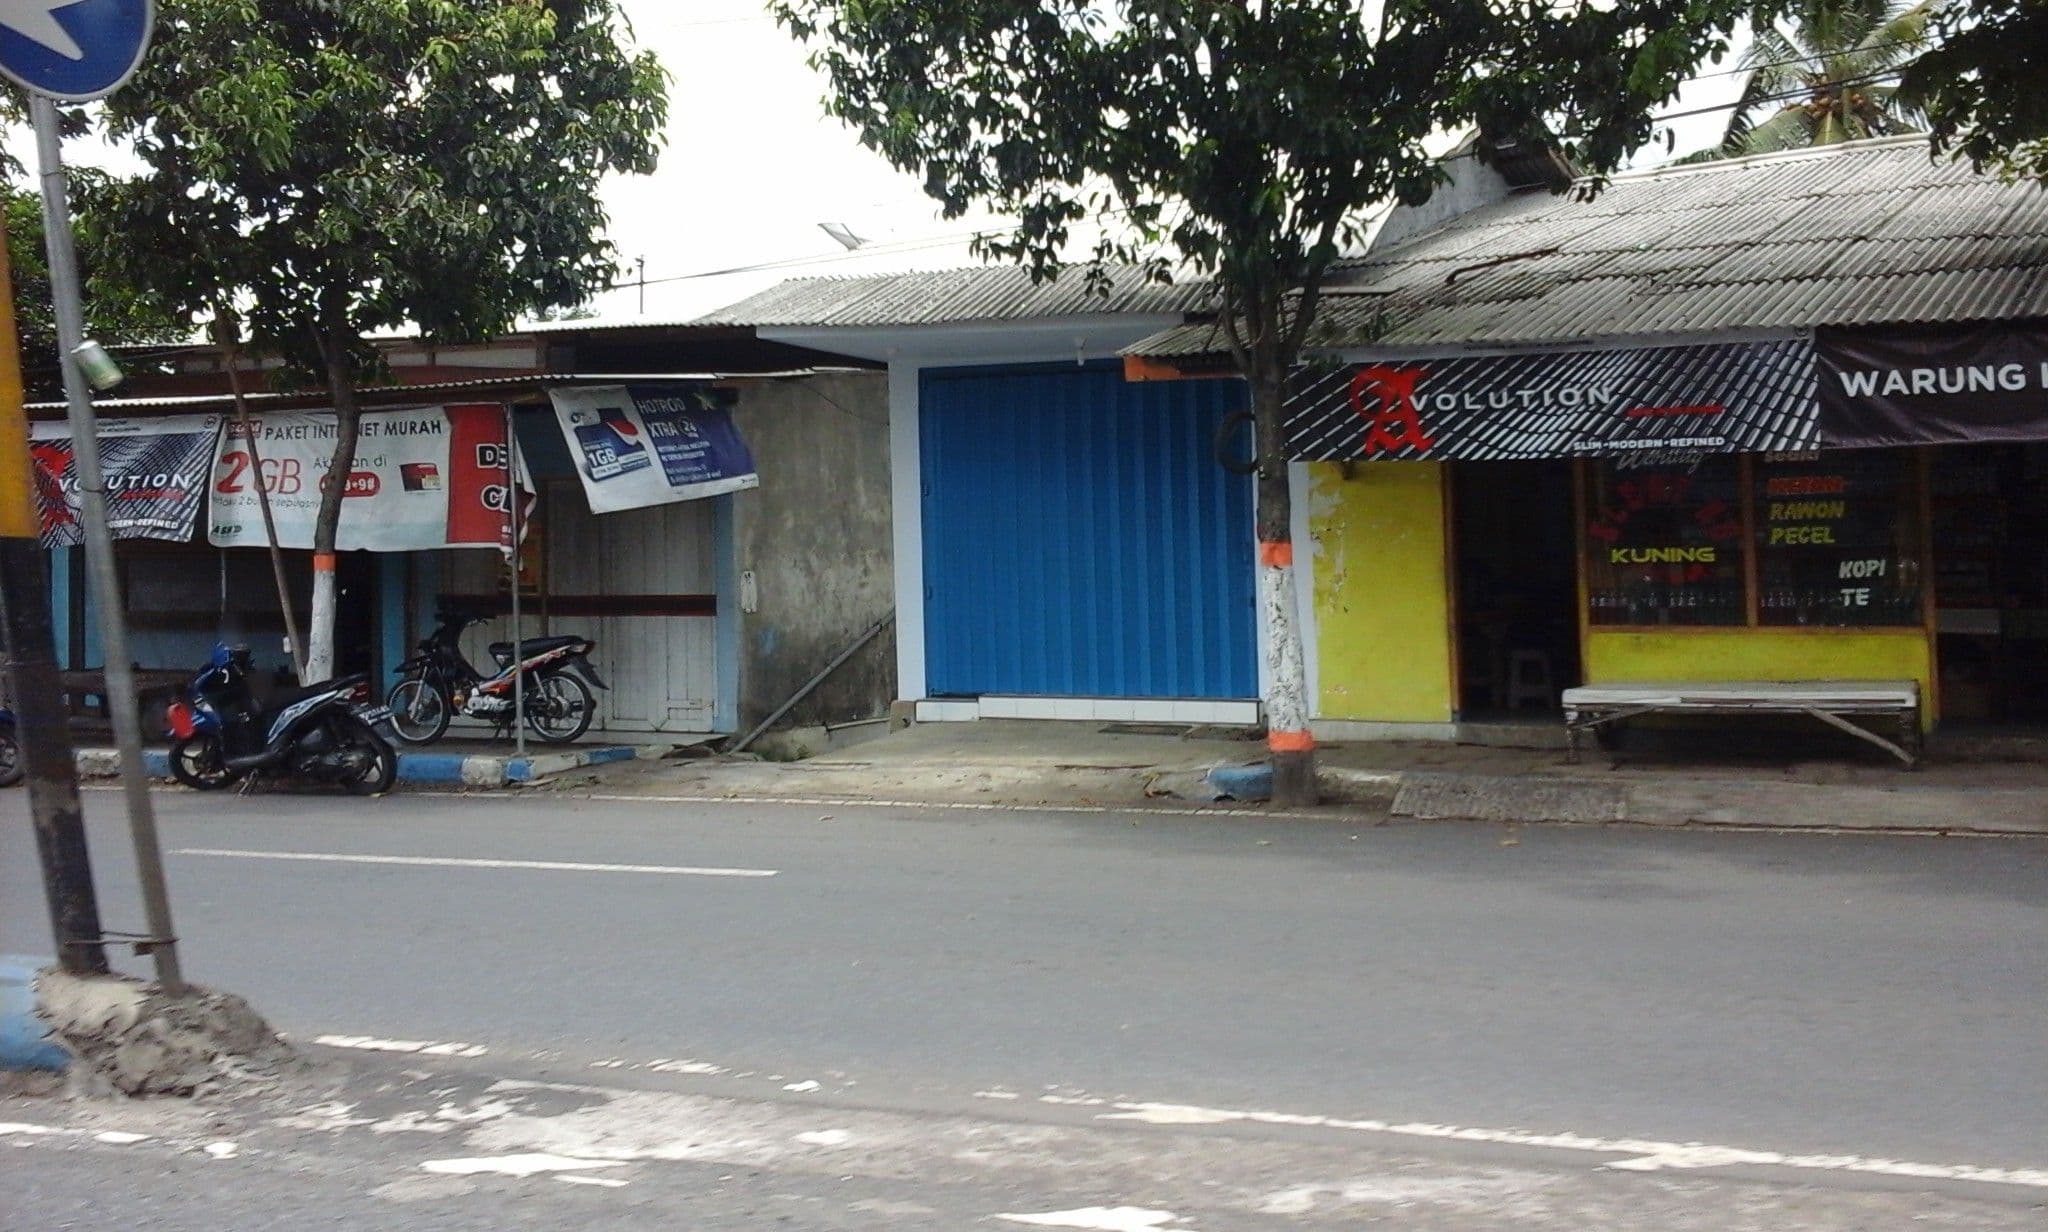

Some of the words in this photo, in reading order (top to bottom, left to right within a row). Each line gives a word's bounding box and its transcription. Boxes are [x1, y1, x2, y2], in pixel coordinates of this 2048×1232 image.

[1839, 364, 2026, 397] WARUNG
[265, 424, 309, 440] PAKET
[385, 420, 442, 435] MURAH
[646, 421, 680, 438] XTRA
[587, 447, 618, 467] 1GB
[1770, 501, 1845, 520] RAWON
[1770, 527, 1836, 545] PECEL
[1611, 546, 1717, 564] KUNING
[1839, 560, 1886, 579] KOPI
[1841, 587, 1870, 607] TE
